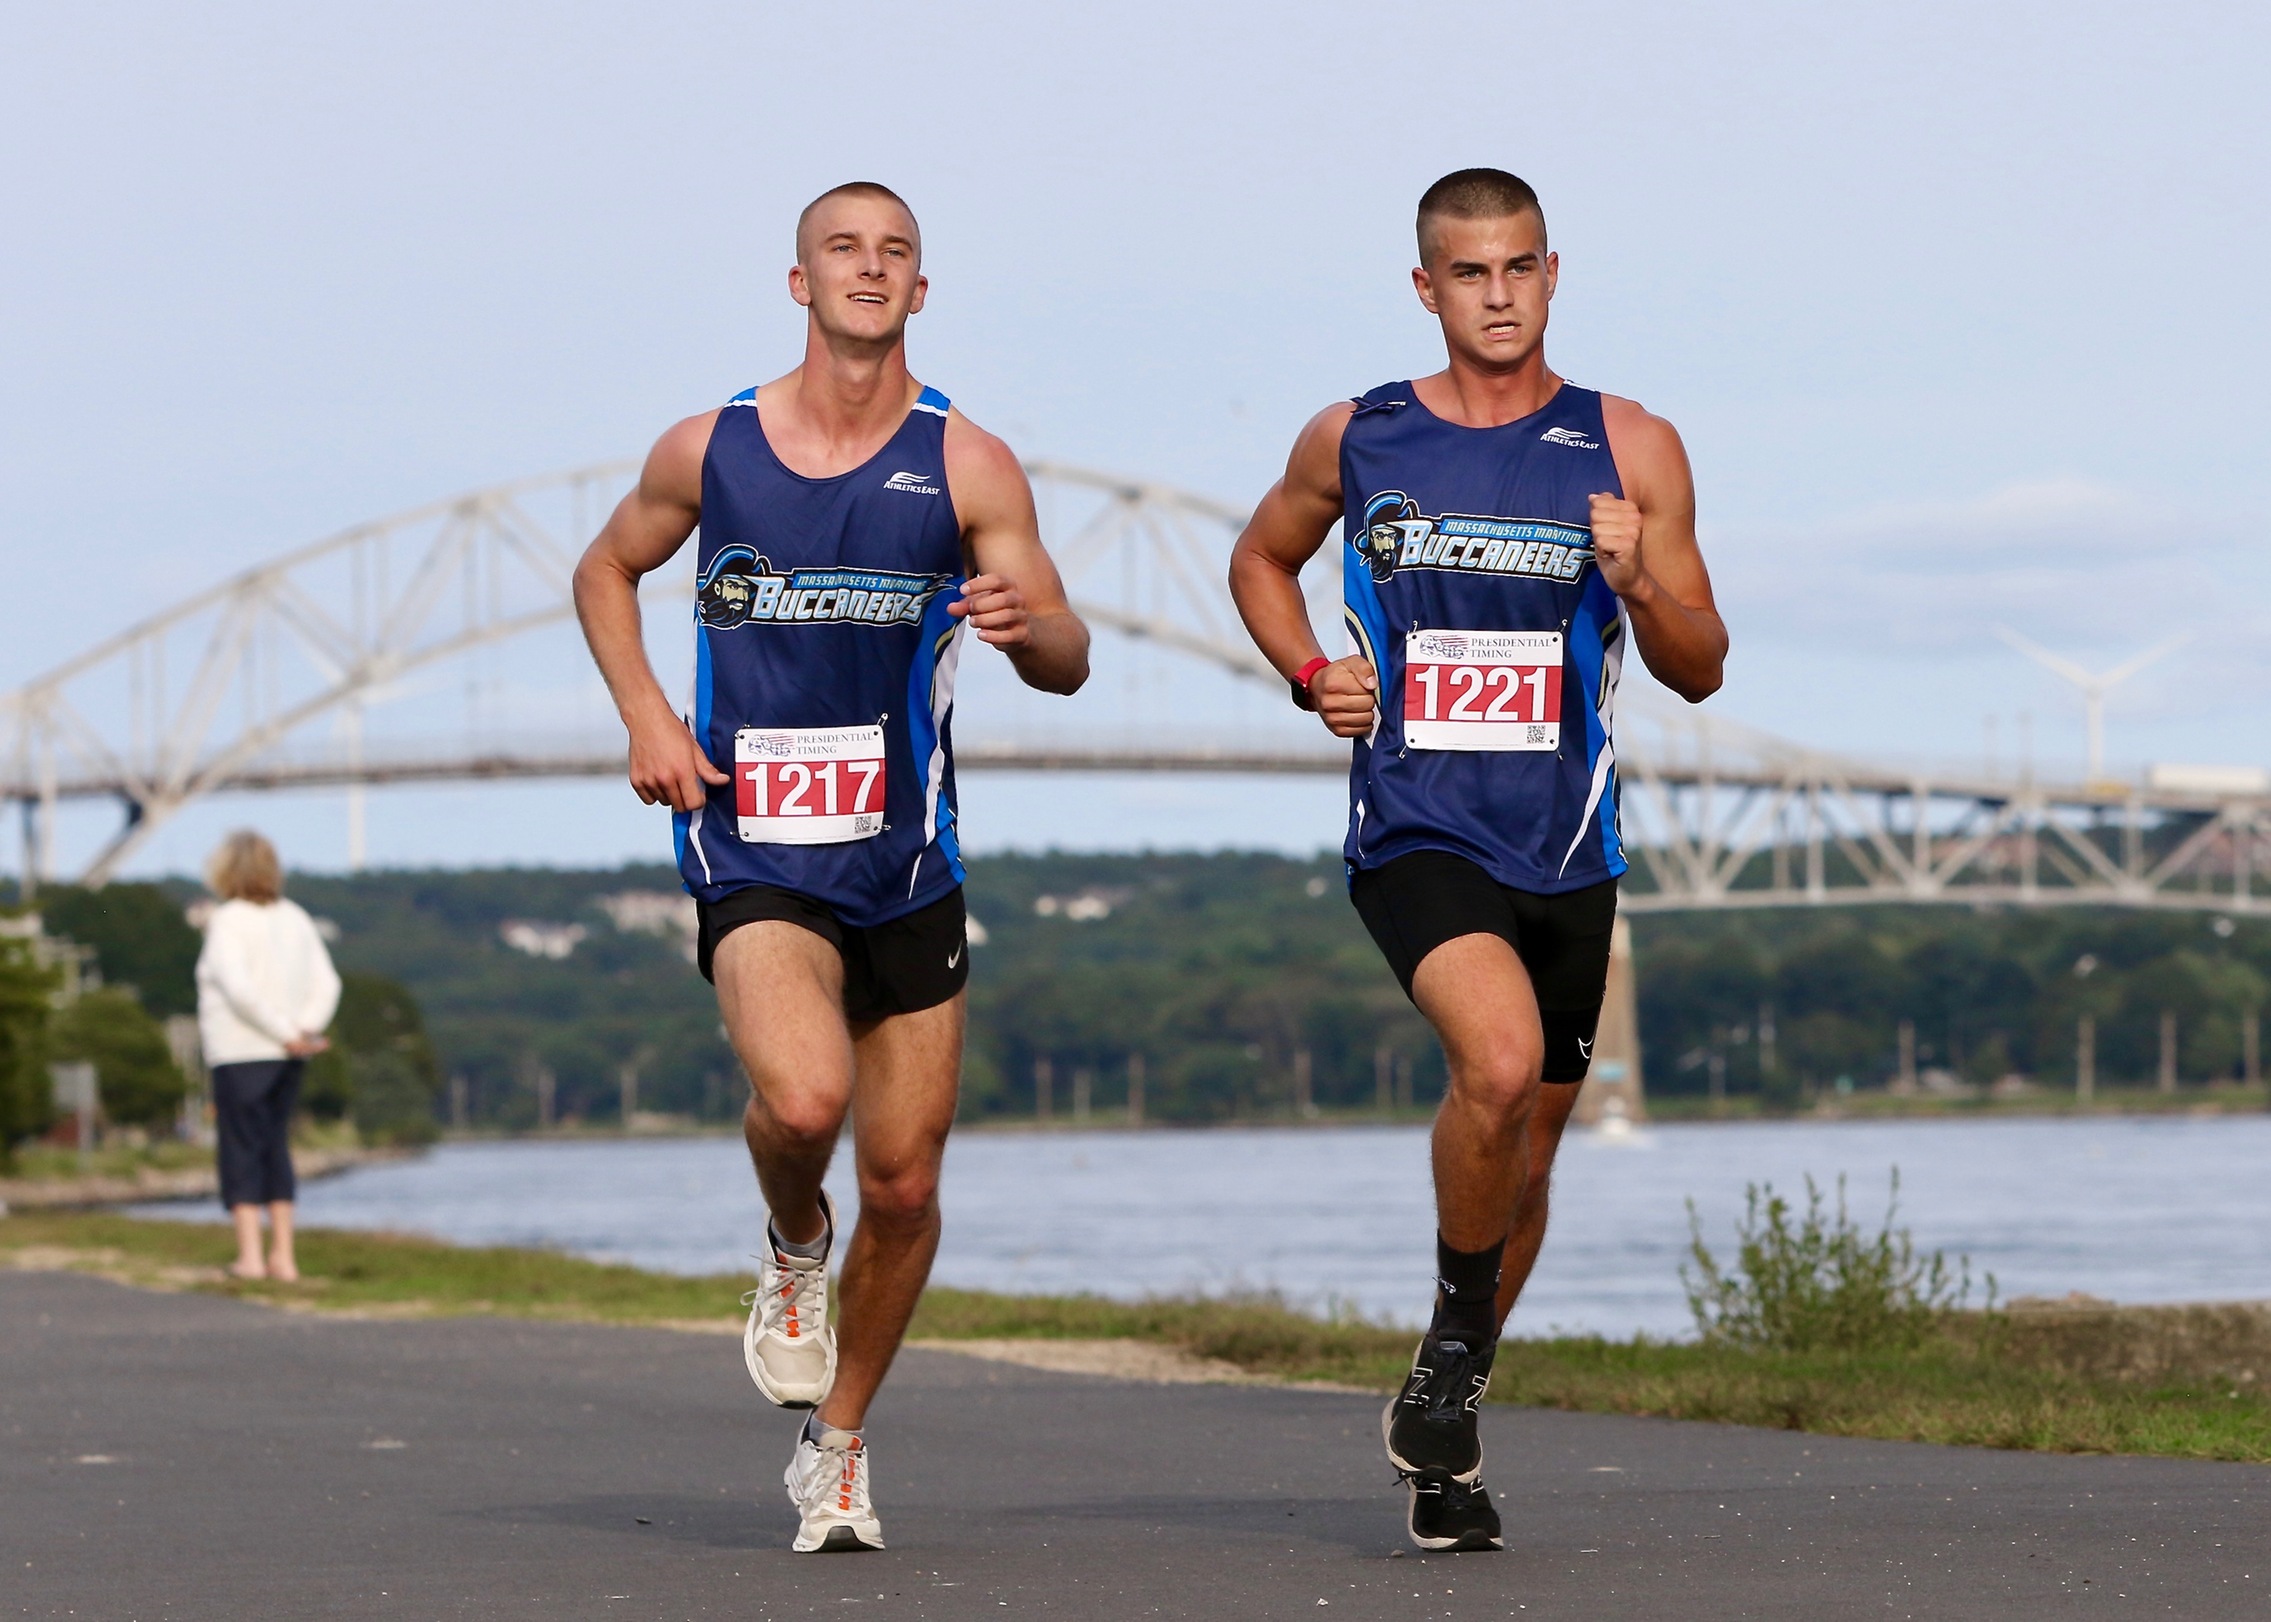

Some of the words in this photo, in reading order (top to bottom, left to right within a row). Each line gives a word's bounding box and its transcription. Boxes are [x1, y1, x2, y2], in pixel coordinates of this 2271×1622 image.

[1540, 433, 1580, 447] ATHLETICS
[1579, 440, 1600, 449] EAST
[883, 480, 921, 493] ATHLETICS
[921, 485, 940, 495] EAST
[1445, 521, 1533, 538] MASSACHUSETTS
[1533, 527, 1588, 545] MARITIME
[1390, 519, 1592, 579] BUCCANEERS
[797, 574, 878, 588] MASSAHUSETTS
[746, 575, 928, 622] BUCCANEERS
[1471, 638, 1551, 648] PRESIDENTIAL
[1471, 650, 1512, 658] TIMING
[1415, 665, 1547, 721] 1221
[797, 732, 873, 744] PRESIDENTIAL
[797, 745, 837, 755] TIMING
[745, 761, 880, 816] 1217
